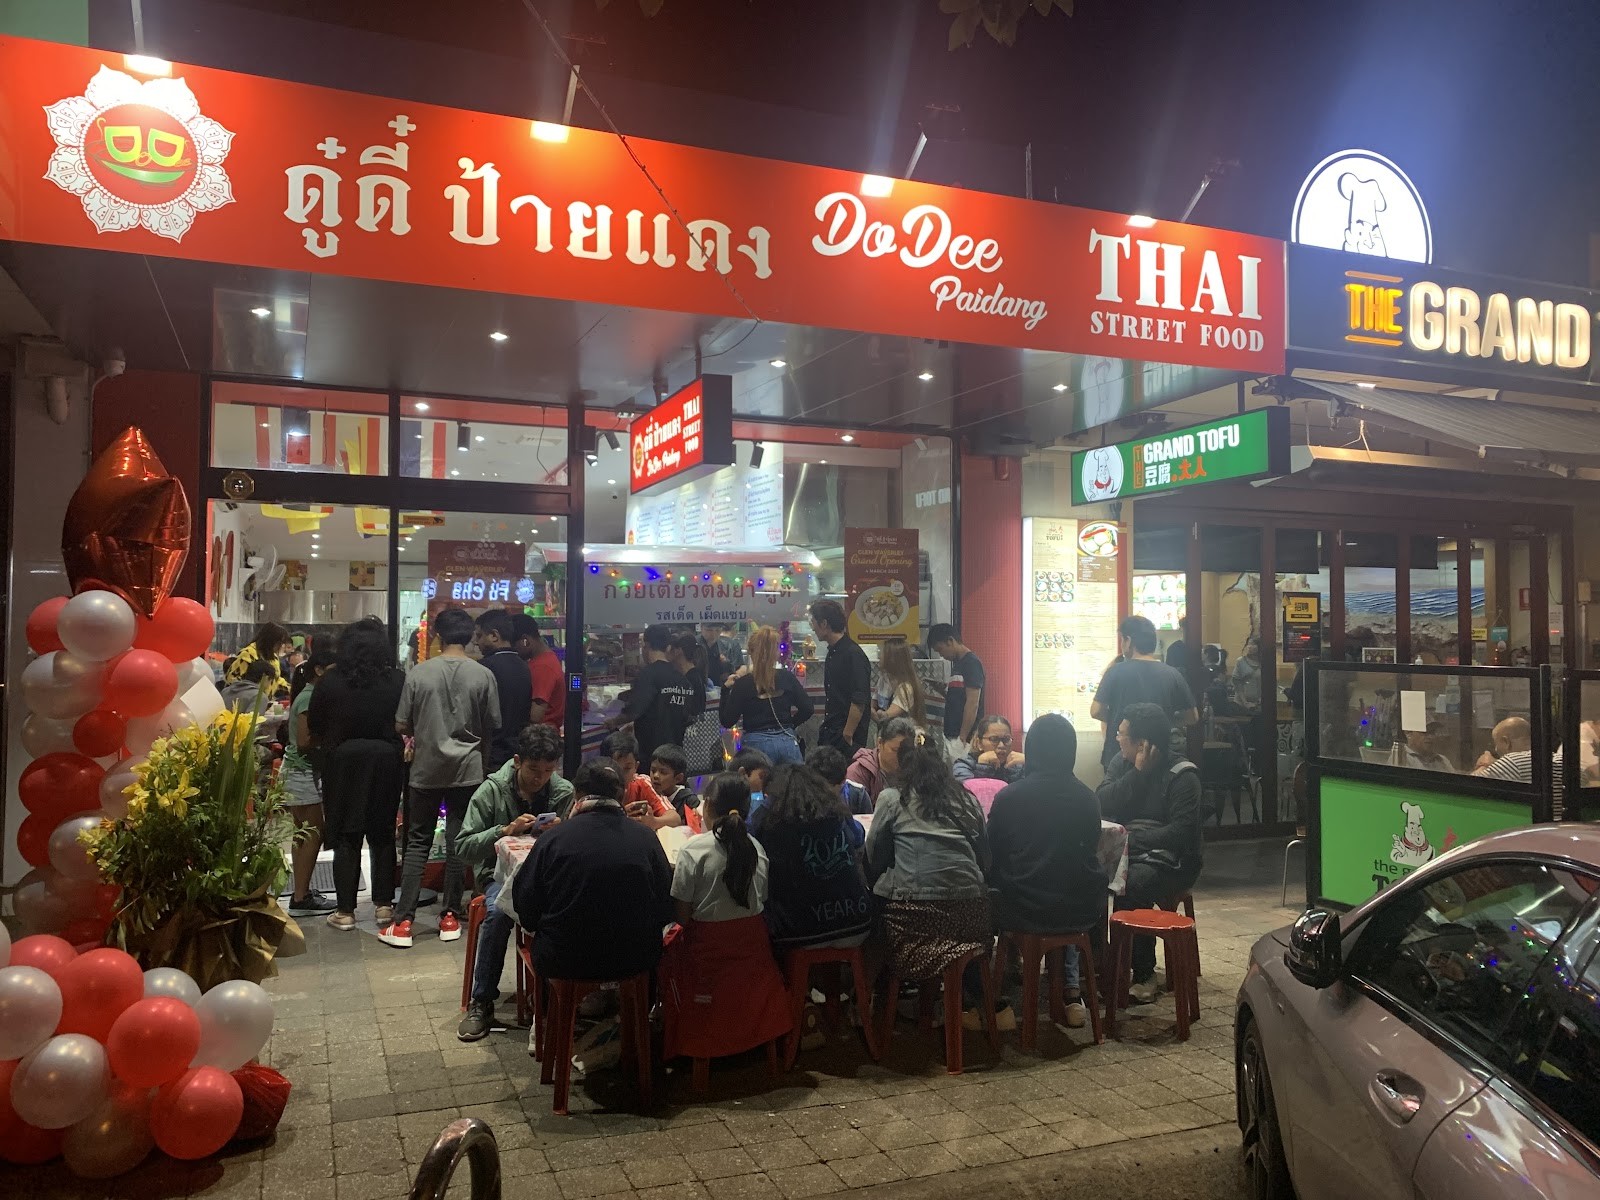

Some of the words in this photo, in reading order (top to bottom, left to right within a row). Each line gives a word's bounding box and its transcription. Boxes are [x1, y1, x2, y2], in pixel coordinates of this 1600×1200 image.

[443, 156, 773, 280] ป้ายแดง
[1088, 228, 1262, 321] THAI
[930, 275, 1048, 331] Paidang
[1090, 310, 1187, 344] STREET
[1200, 324, 1264, 352] FOOD
[1345, 283, 1404, 334] THE
[1409, 281, 1591, 369] GRAND
[683, 396, 700, 421] THAI
[683, 419, 701, 439] STREET
[685, 436, 699, 454] FOOD
[1143, 434, 1195, 464] GRAND
[1196, 423, 1240, 453] TOFU
[1373, 859, 1398, 875] the
[811, 900, 855, 921] YEAR
[858, 896, 867, 913] 6
